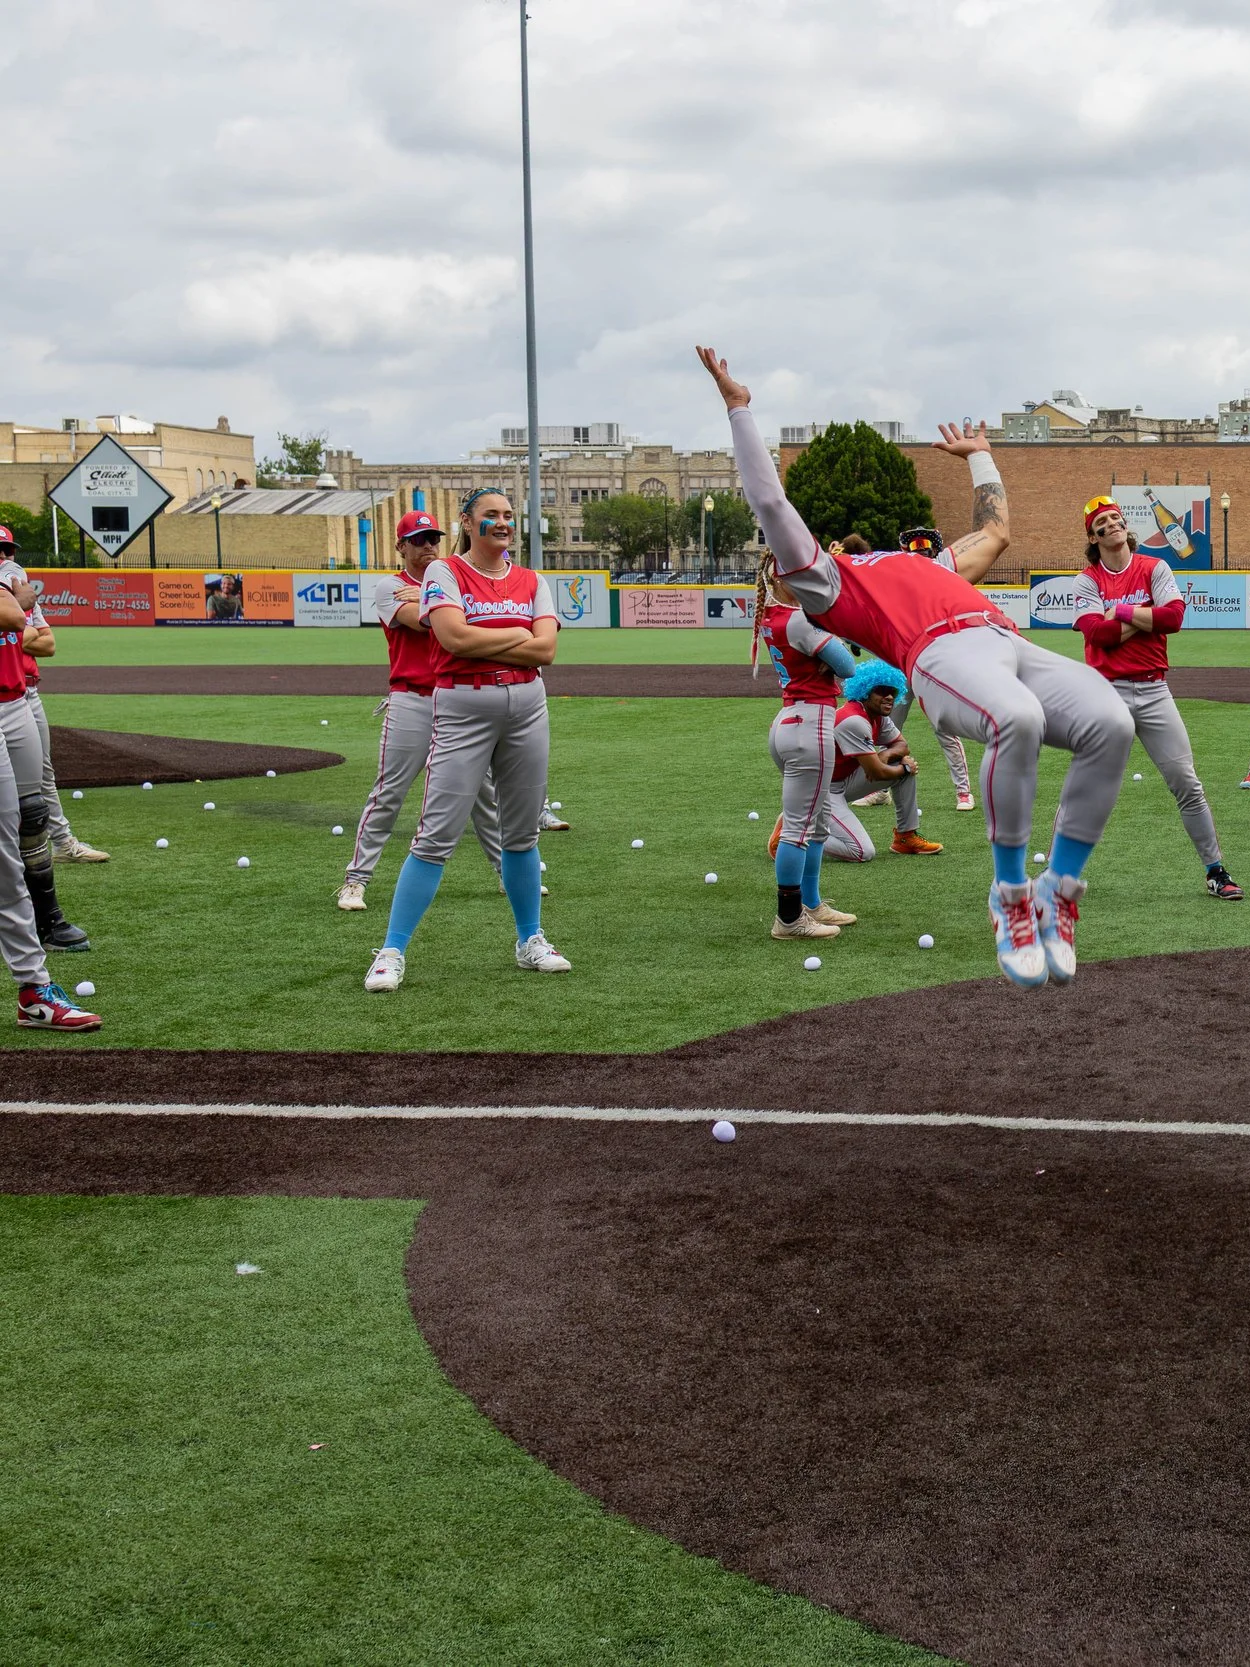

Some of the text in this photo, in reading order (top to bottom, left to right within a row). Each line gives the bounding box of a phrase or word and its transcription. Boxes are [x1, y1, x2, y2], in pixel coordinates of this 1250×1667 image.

[102, 534, 122, 544] MPH
[158, 581, 181, 590] Game
[159, 591, 201, 599] Cheer loud.
[247, 590, 289, 603] HOLLYWOOD
[160, 601, 182, 609] Score
[1209, 596, 1241, 605] BEFORE
[94, 600, 151, 611] 815-727-4526
[635, 618, 697, 626] poshbanquets.com
